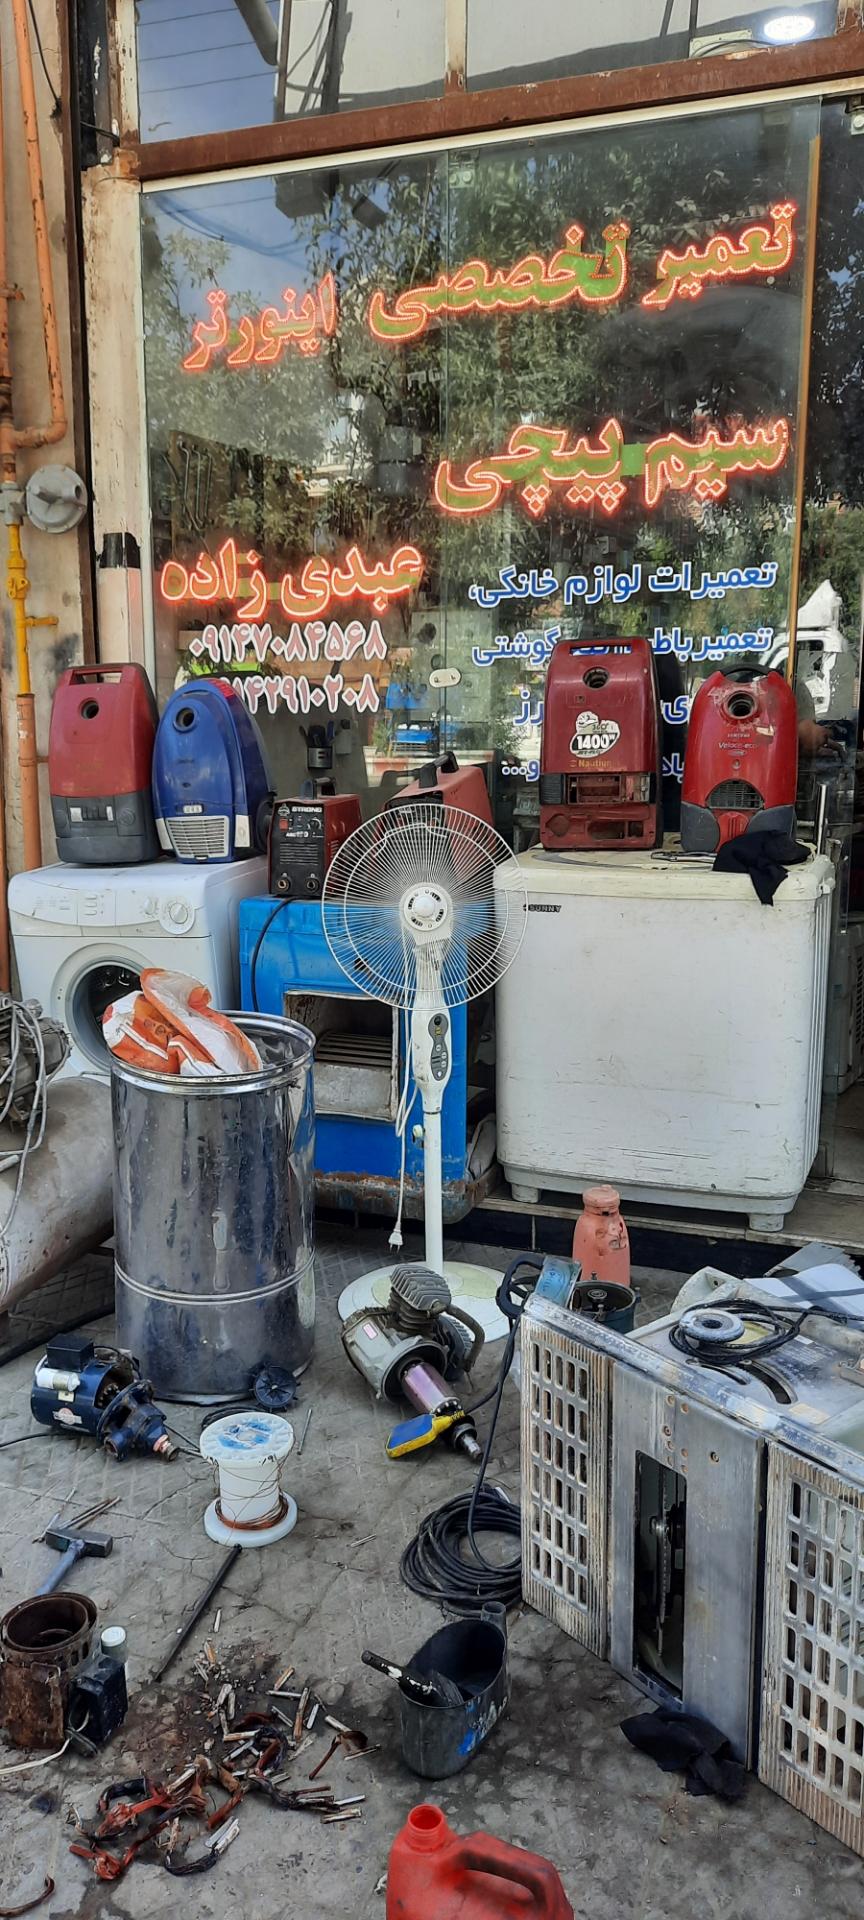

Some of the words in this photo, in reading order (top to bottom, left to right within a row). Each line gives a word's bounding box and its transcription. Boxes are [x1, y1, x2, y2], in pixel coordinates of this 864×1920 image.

[369, 223, 629, 341] تخصصی
[642, 203, 796, 304] تعمیر
[183, 272, 337, 368] اینورتر
[434, 418, 624, 514] پیچی
[645, 418, 788, 505] سیم
[161, 538, 267, 619] زاده
[281, 546, 422, 617] عبدی
[564, 564, 643, 605] لوازم
[648, 561, 779, 599] تعمیرات
[691, 627, 774, 662] تعمیر
